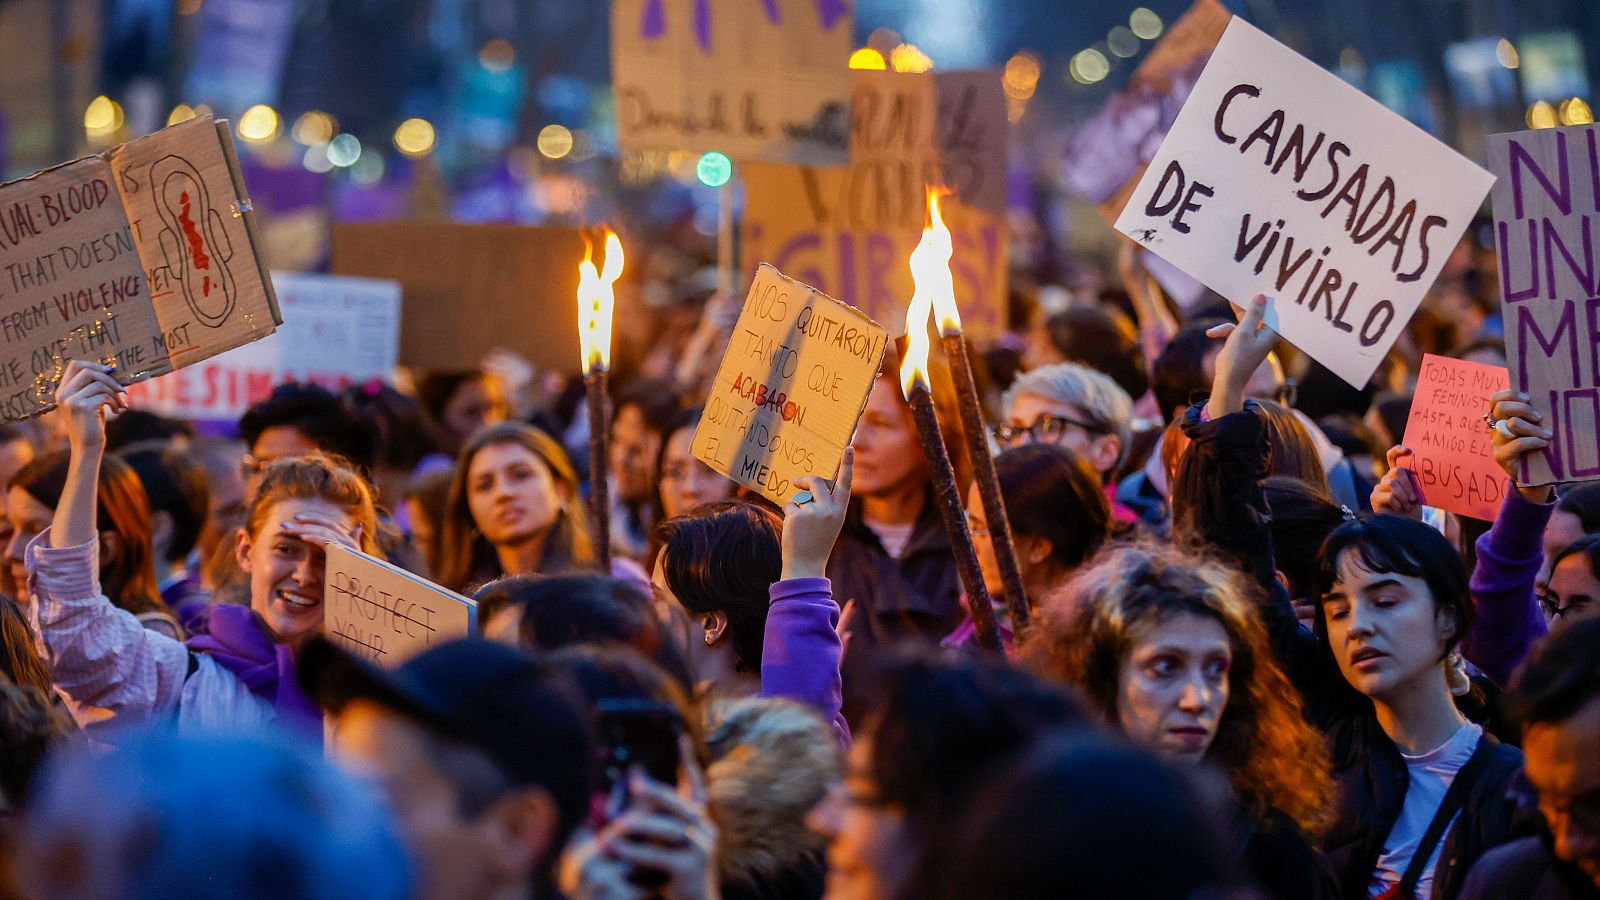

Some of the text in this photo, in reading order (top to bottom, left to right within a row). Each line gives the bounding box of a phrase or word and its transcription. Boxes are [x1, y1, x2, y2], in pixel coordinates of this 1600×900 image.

[40, 178, 108, 227] BLOOD
[119, 164, 139, 194] IS
[1144, 160, 1214, 234] DE
[1213, 83, 1448, 282] CANSADAS
[1508, 128, 1600, 220] NI
[5, 253, 57, 293] THAT
[1498, 213, 1600, 304] UN
[1, 302, 49, 343] FROM
[53, 275, 141, 322] VIOLENCE
[746, 282, 879, 365] NOS QUITARON
[0, 357, 23, 388] HE
[70, 313, 122, 355] THAT
[114, 322, 192, 372] THE MOST
[744, 329, 844, 402] TANTO QUE
[730, 372, 807, 428] ACABARON
[1472, 369, 1504, 392] MUY
[1414, 406, 1453, 431] HASTA
[1459, 416, 1482, 433] QUE
[1469, 439, 1489, 458] EL
[703, 436, 789, 497] EL MIEDO
[1408, 453, 1510, 506] ABUSADO
[333, 571, 436, 645] PROTECT
